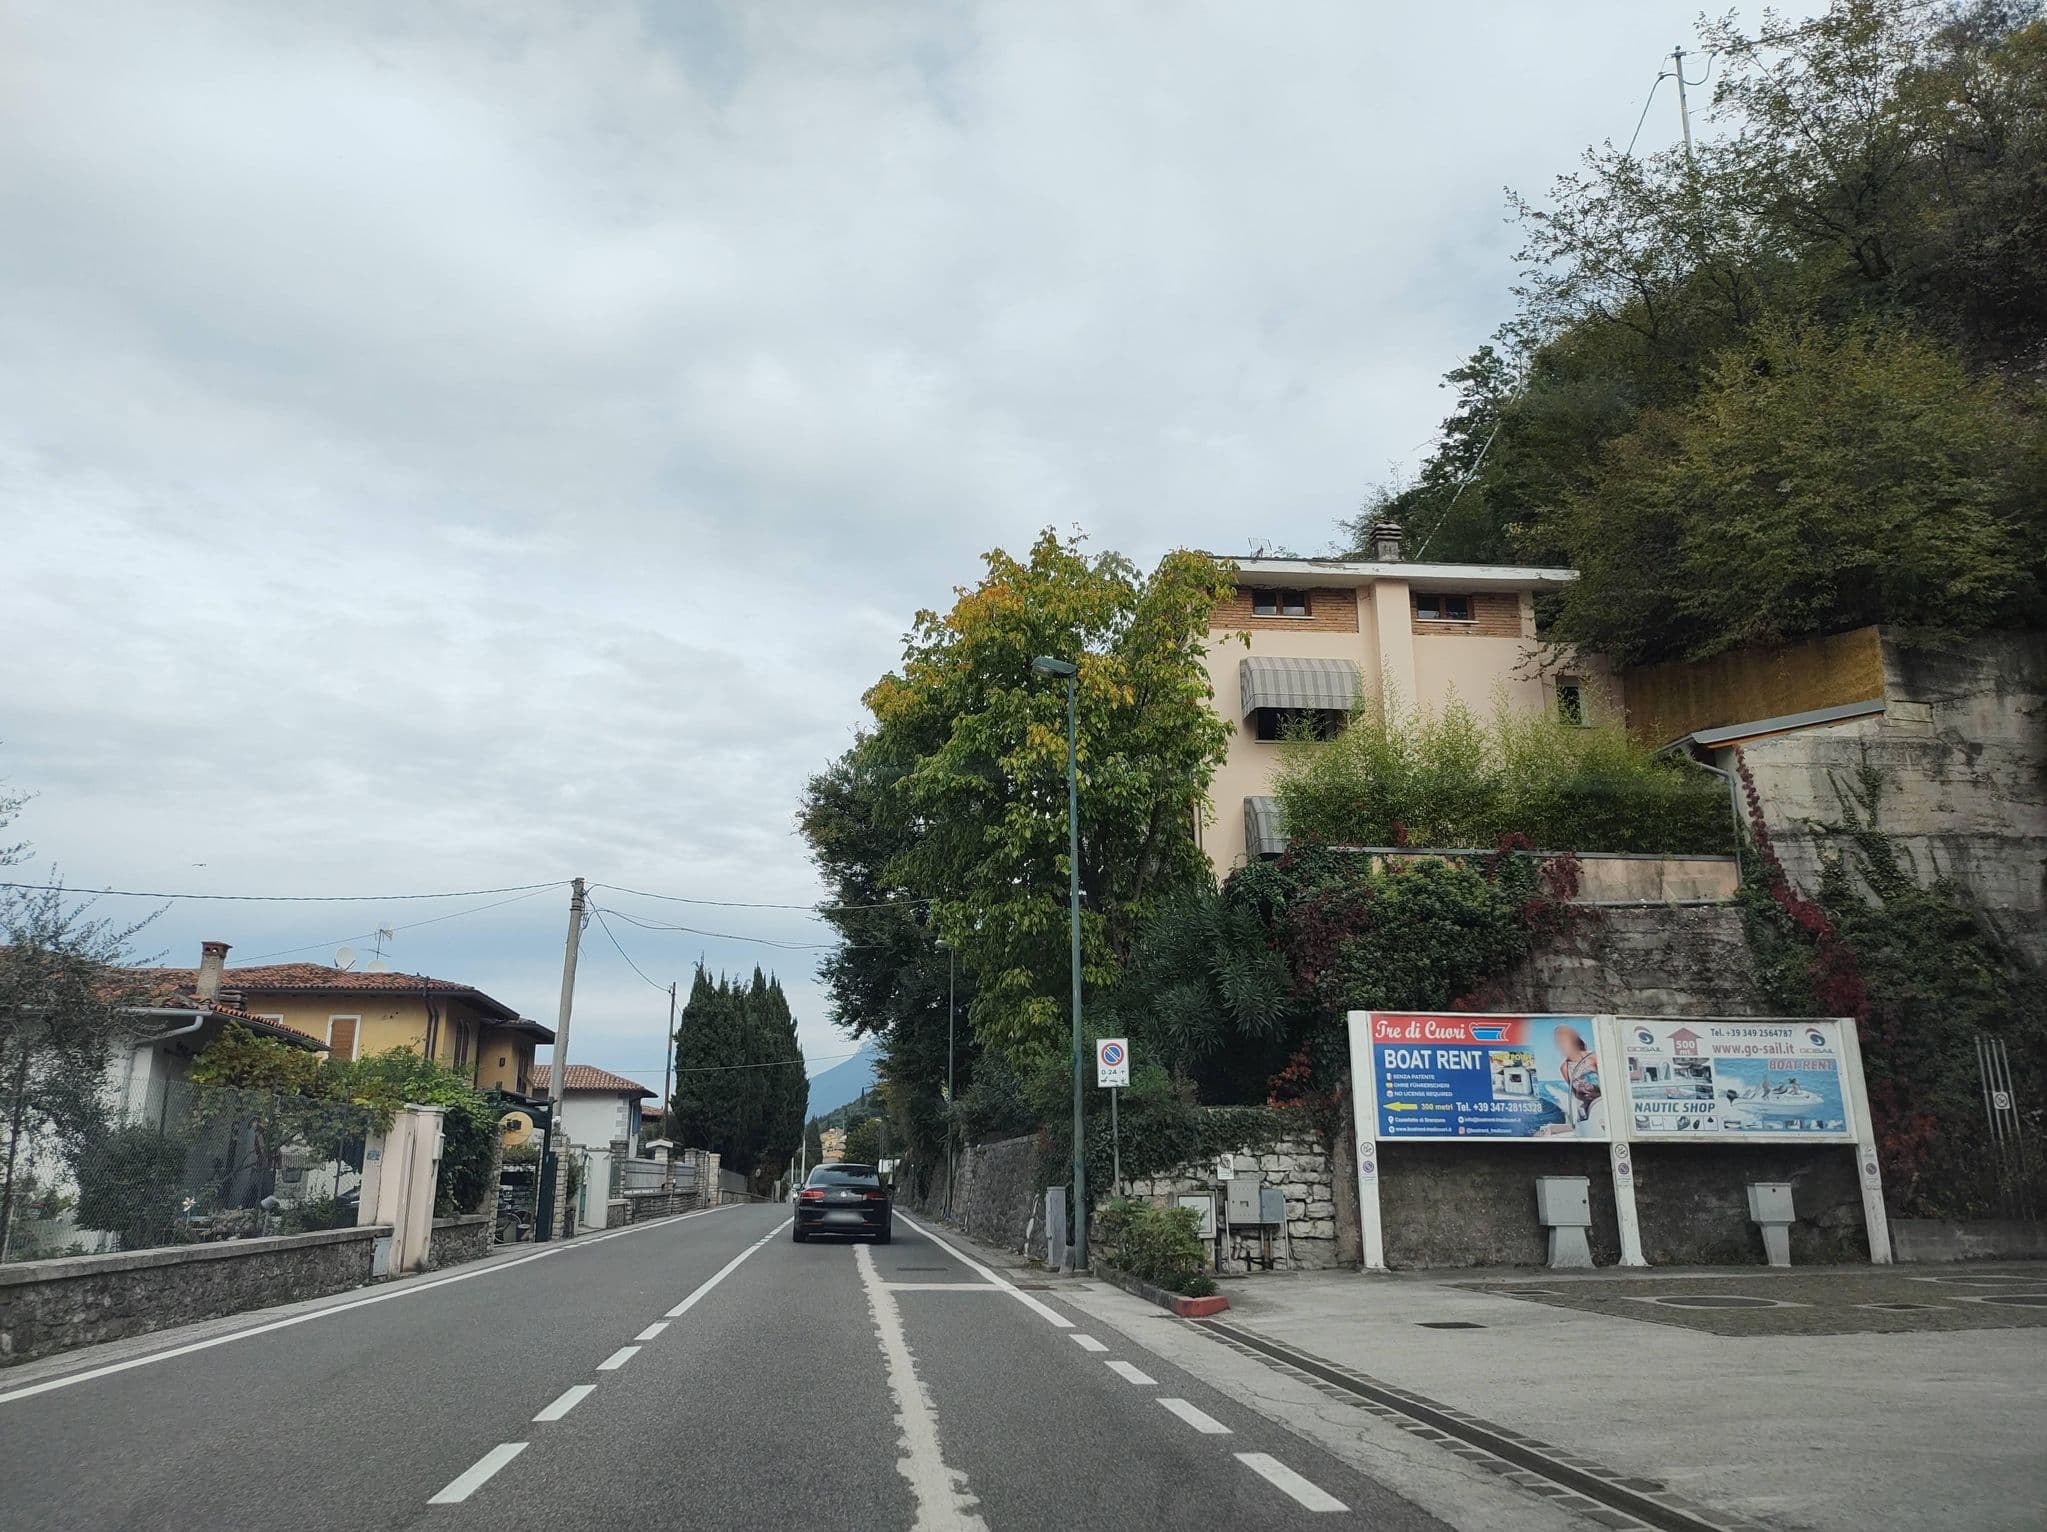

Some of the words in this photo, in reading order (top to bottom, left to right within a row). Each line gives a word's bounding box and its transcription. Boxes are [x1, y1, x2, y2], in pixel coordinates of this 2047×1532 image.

[1375, 1020, 1402, 1038] Tre
[1405, 1021, 1421, 1039] di
[1425, 1021, 1466, 1039] Cuori
[1711, 1029, 1725, 1037] Tel.
[1759, 1030, 1792, 1038] 2564787
[1676, 1040, 1695, 1049] 500
[1712, 1042, 1795, 1057] www.go-sail.it
[1384, 1049, 1432, 1069] BOAT
[1437, 1050, 1482, 1070] RENT
[1769, 1060, 1798, 1070] BOAT
[1803, 1060, 1832, 1071] RENT
[1421, 1103, 1434, 1111] 300
[1435, 1103, 1454, 1111] metri
[1456, 1102, 1472, 1112] Tel.
[1473, 1102, 1488, 1112] +39
[1490, 1102, 1543, 1112] 347-2815328
[1634, 1102, 1679, 1113] NAUTIC
[1683, 1102, 1716, 1113] SHOP
